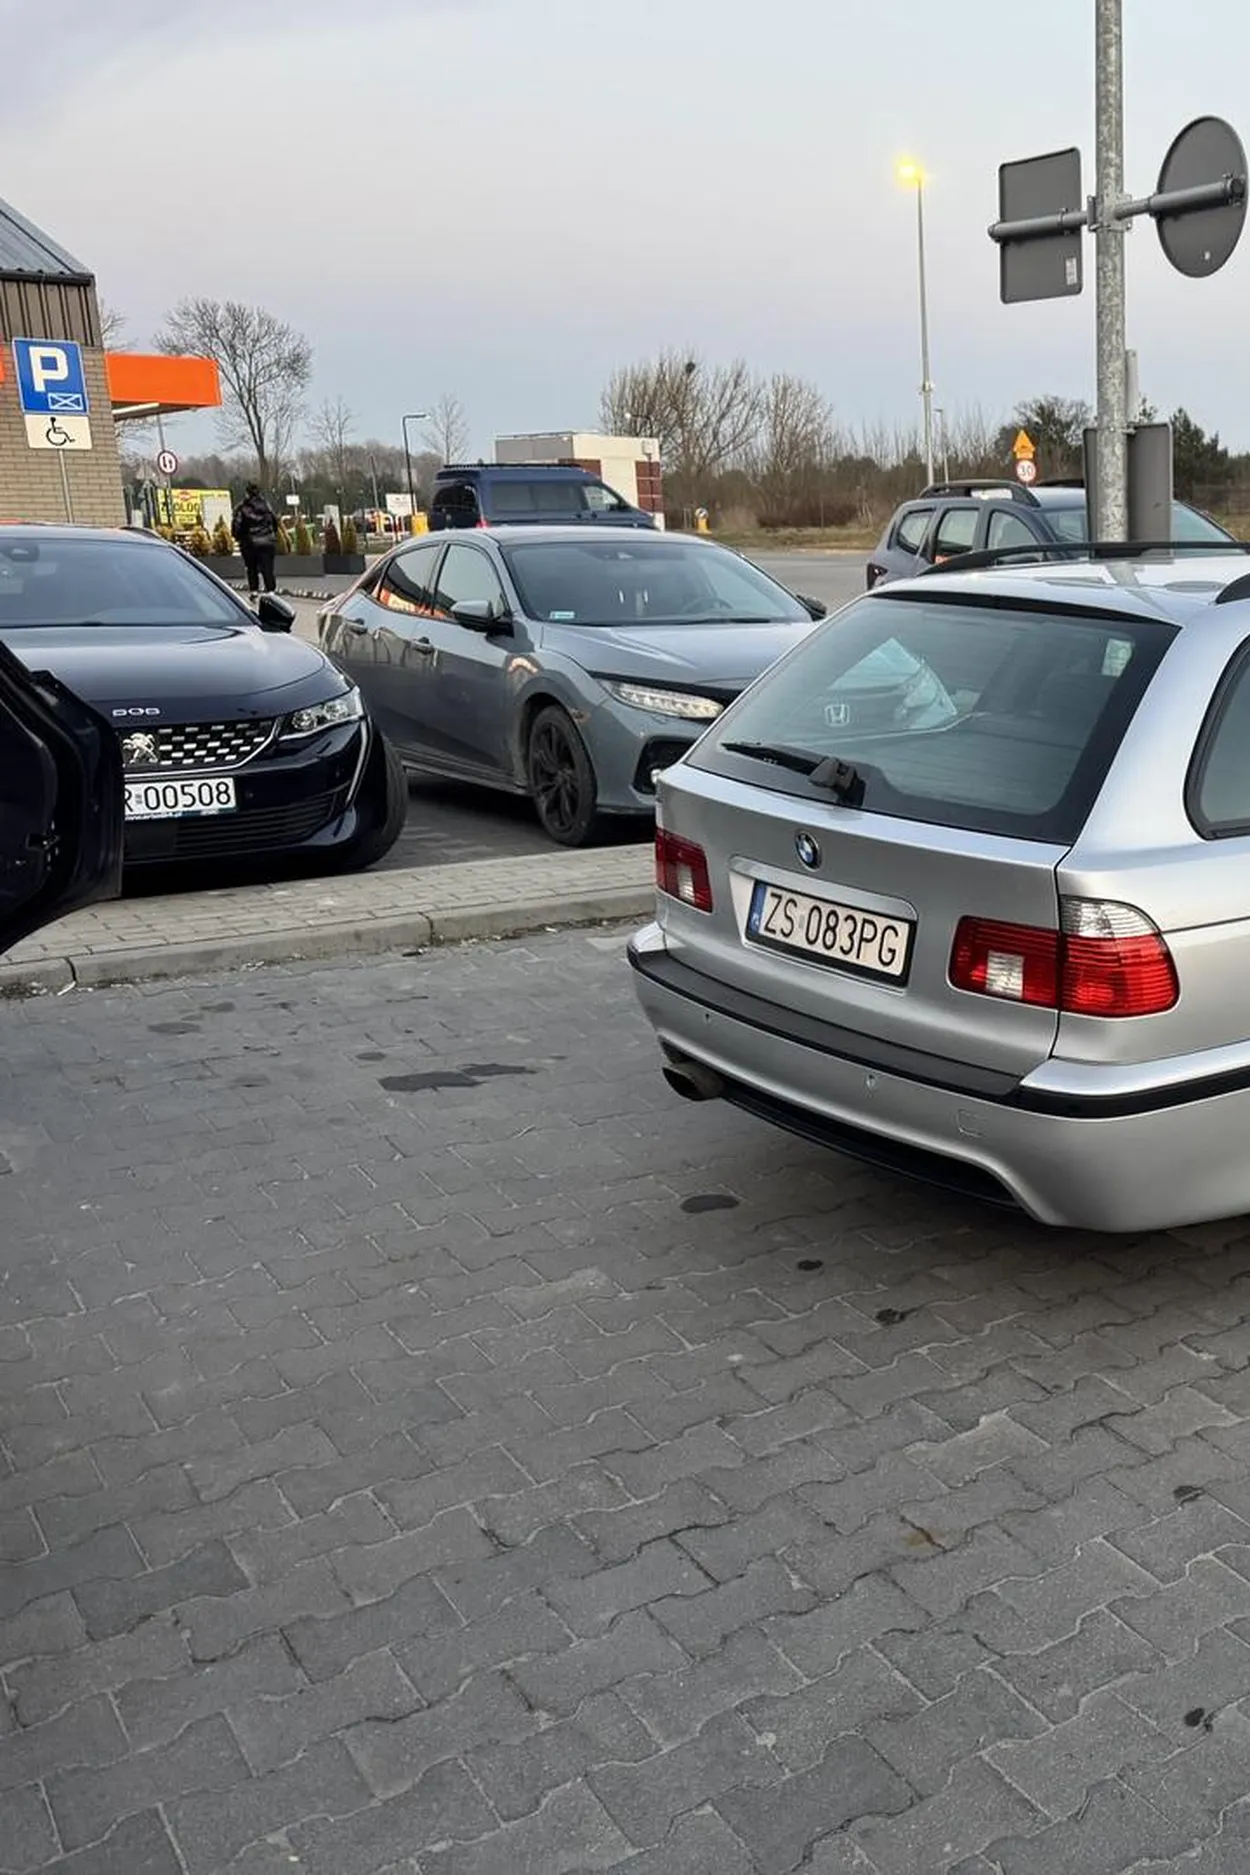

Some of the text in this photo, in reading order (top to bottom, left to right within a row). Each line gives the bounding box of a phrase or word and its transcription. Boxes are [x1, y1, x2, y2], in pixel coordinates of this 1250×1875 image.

[29, 346, 68, 392] P
[144, 781, 231, 810] 00508
[764, 892, 899, 967] ZS 083PG
